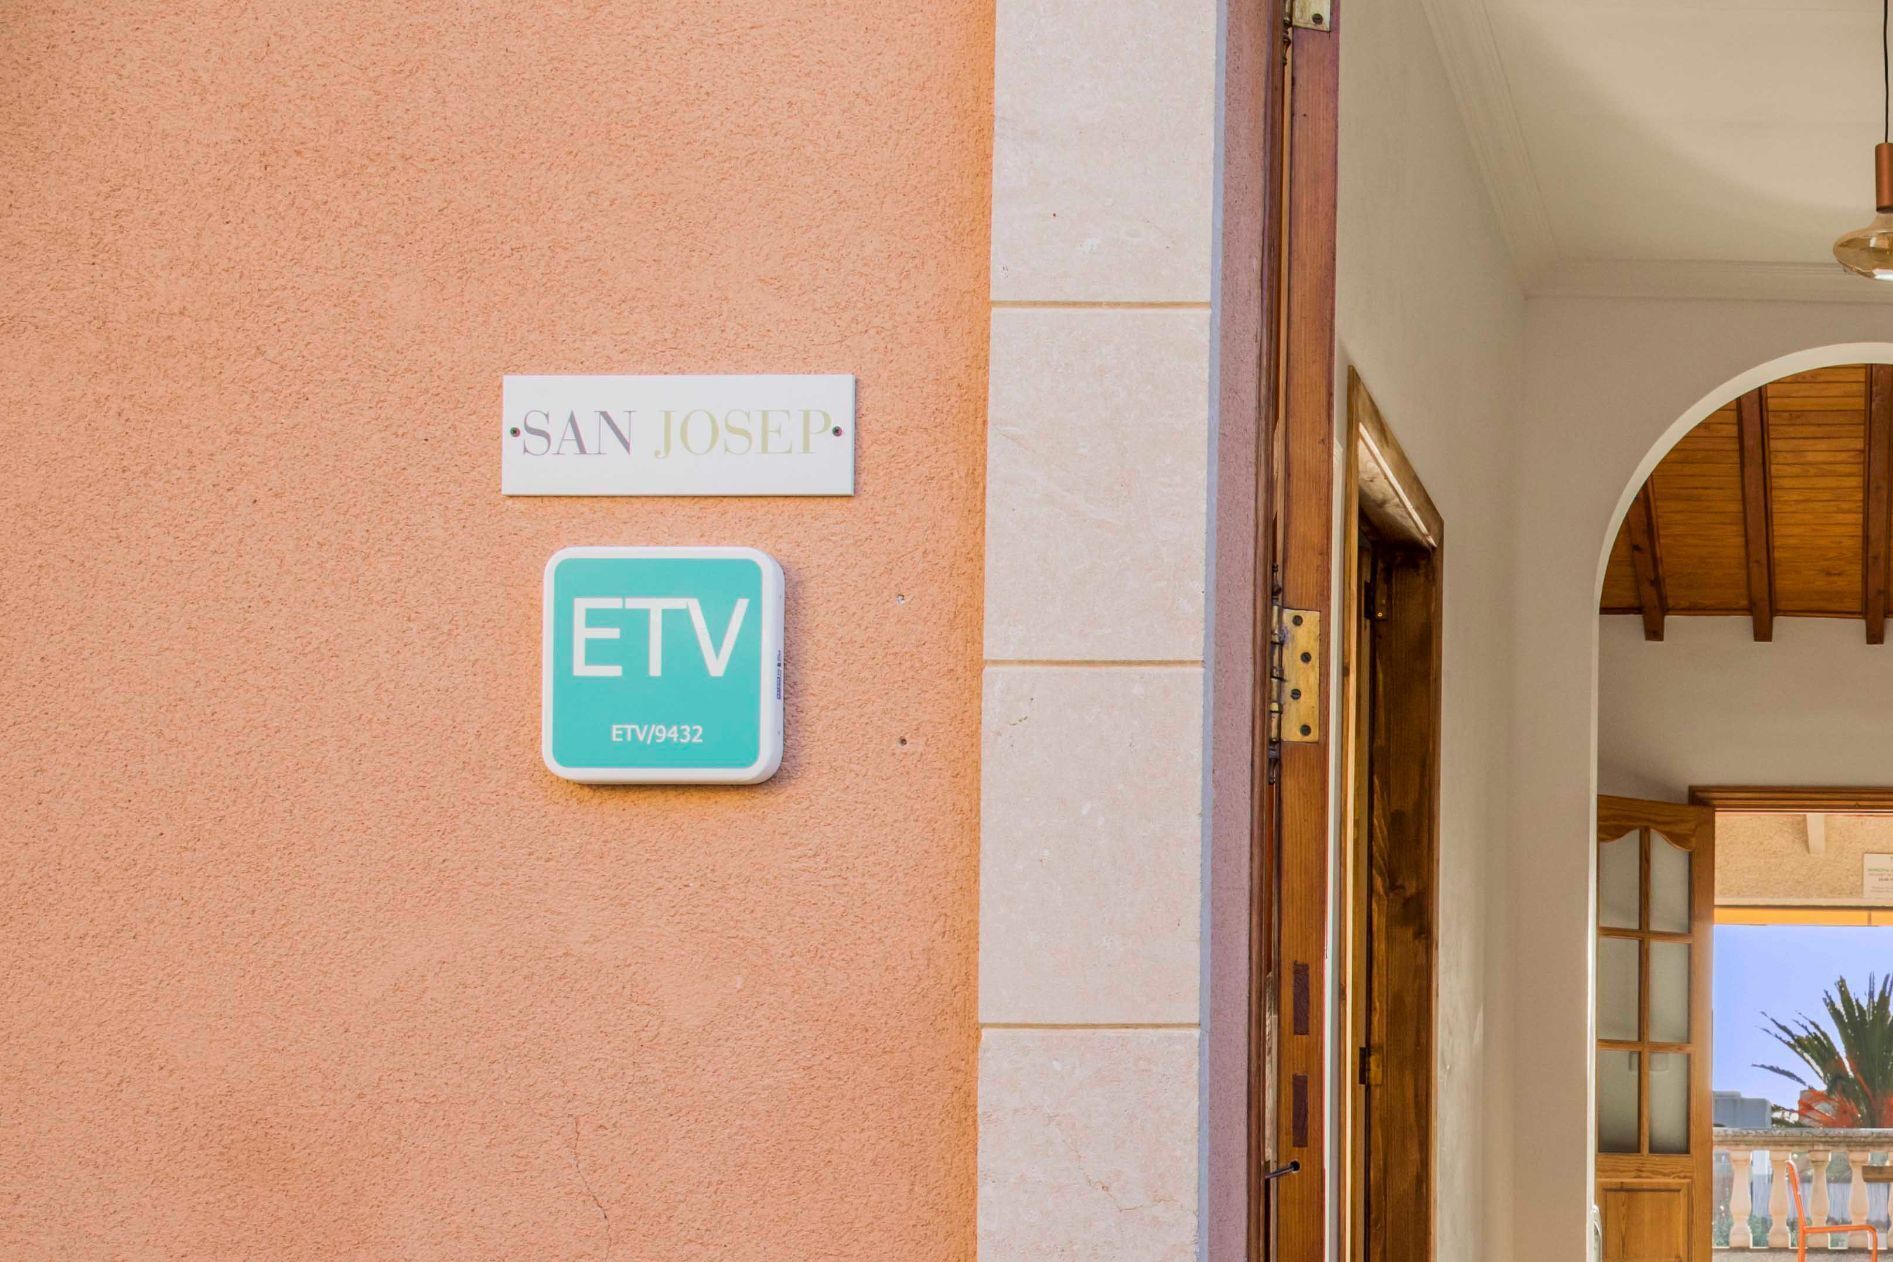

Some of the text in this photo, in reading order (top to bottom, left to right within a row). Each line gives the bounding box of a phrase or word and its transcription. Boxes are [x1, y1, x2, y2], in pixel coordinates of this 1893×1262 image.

[523, 408, 832, 459] SAN JOSEP
[573, 597, 750, 677] ETV
[611, 724, 704, 745] ETV/9432
